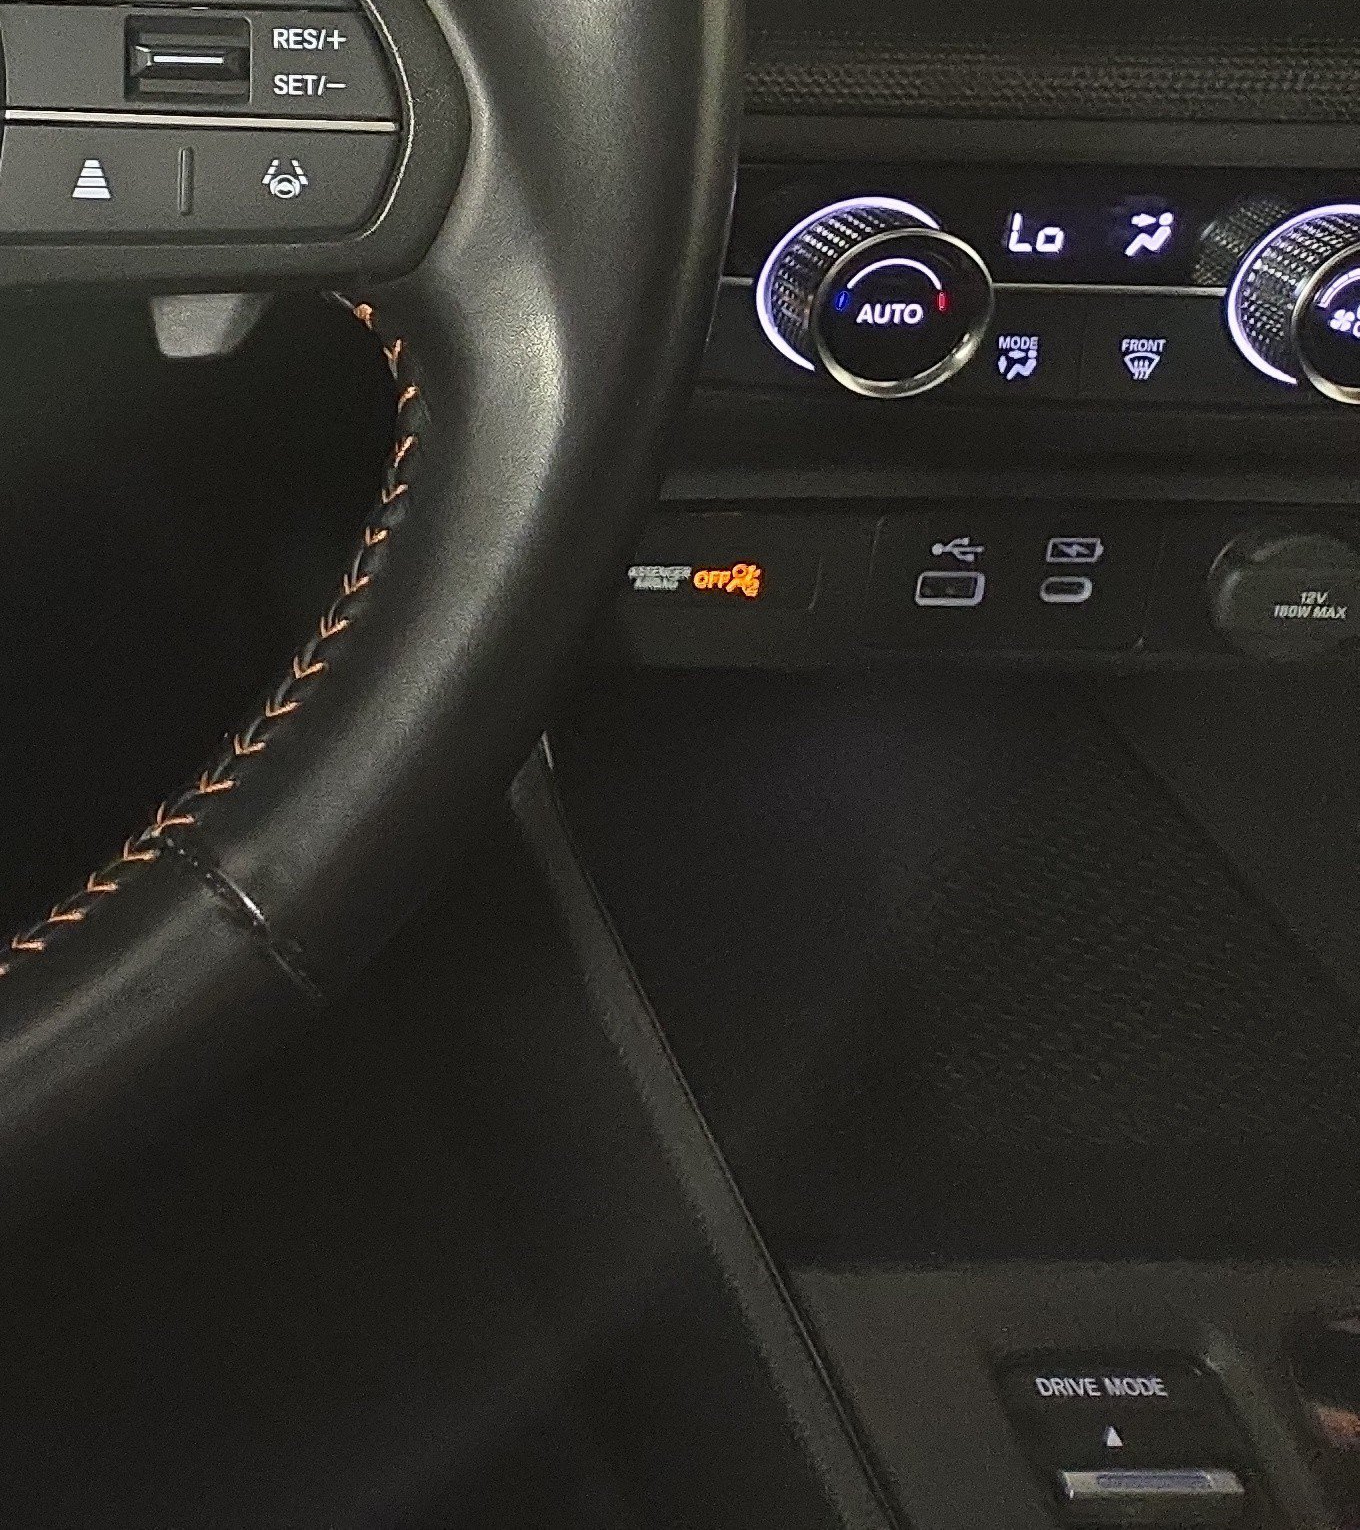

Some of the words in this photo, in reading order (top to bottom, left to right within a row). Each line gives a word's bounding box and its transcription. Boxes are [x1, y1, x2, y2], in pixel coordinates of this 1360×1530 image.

[272, 28, 347, 51] RES/+
[856, 303, 923, 325] AUTO
[998, 336, 1039, 351] MODE
[1122, 338, 1166, 353] FRONT
[1300, 591, 1328, 604] 12V
[1313, 606, 1347, 619] MAX
[1036, 1377, 1100, 1397] DRIVE
[1103, 1377, 1168, 1397] MODE
